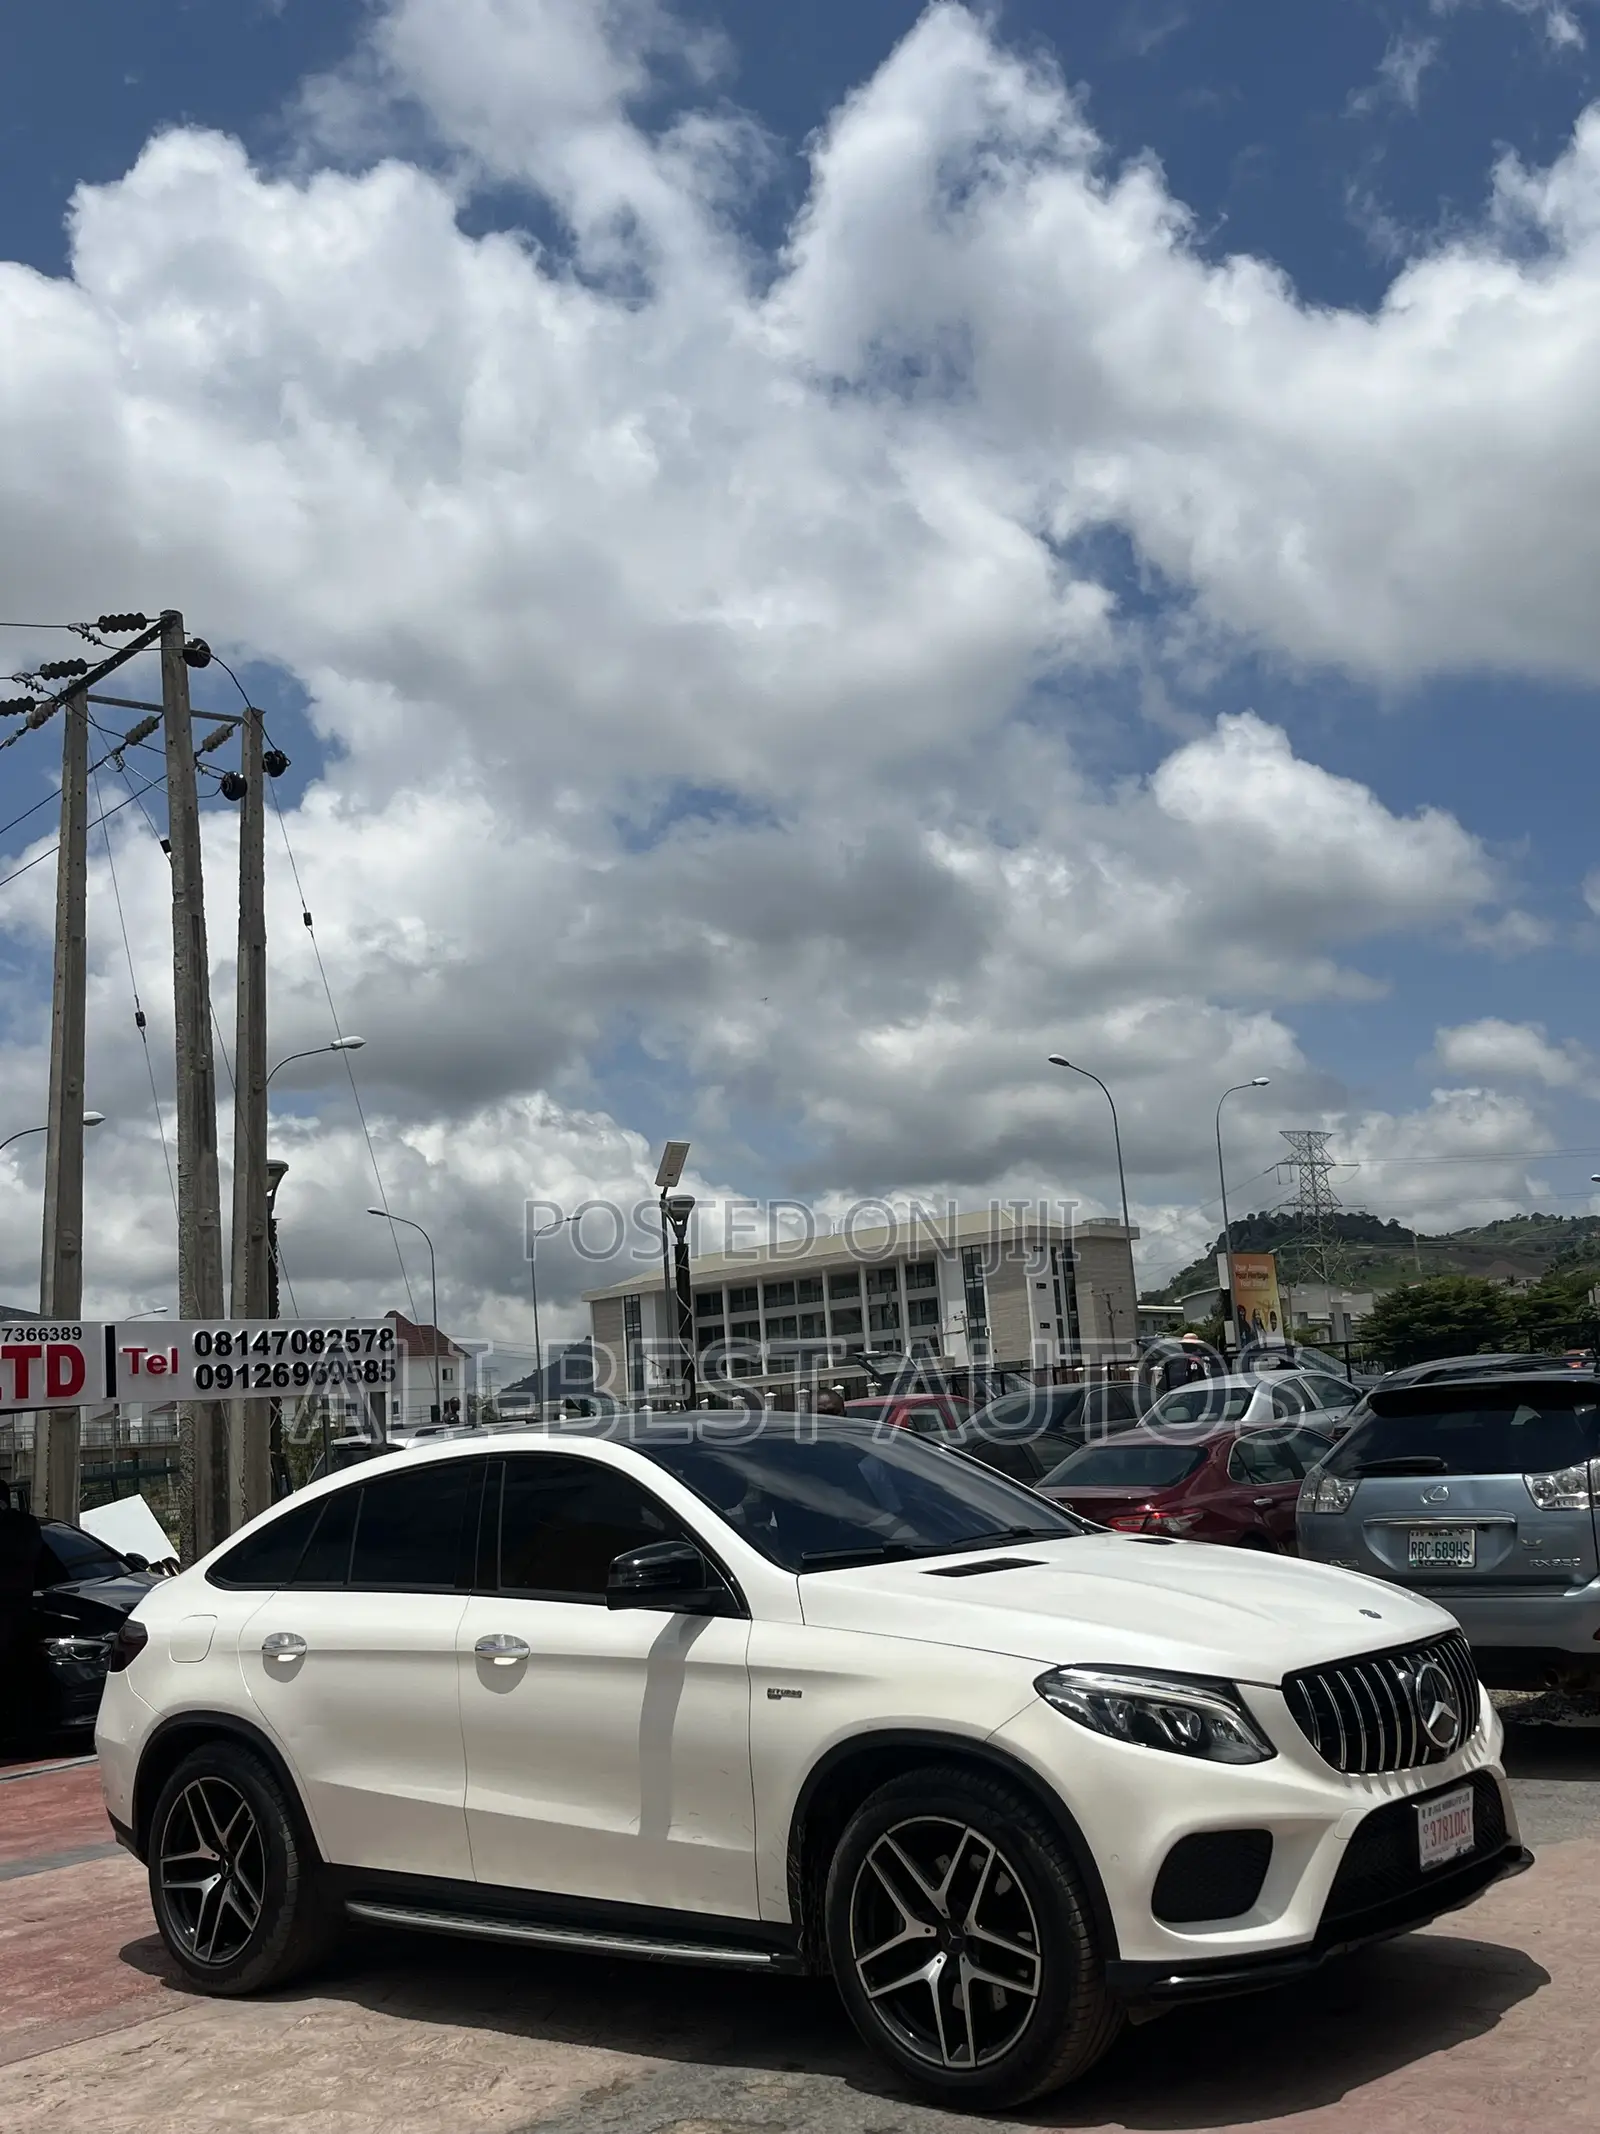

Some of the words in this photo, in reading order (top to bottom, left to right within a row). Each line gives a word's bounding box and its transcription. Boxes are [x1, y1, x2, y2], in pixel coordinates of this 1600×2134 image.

[2, 1326, 82, 1342] 7366389
[194, 1328, 395, 1356] 08147082578
[0, 1344, 86, 1399] TD
[121, 1347, 178, 1375] Tel
